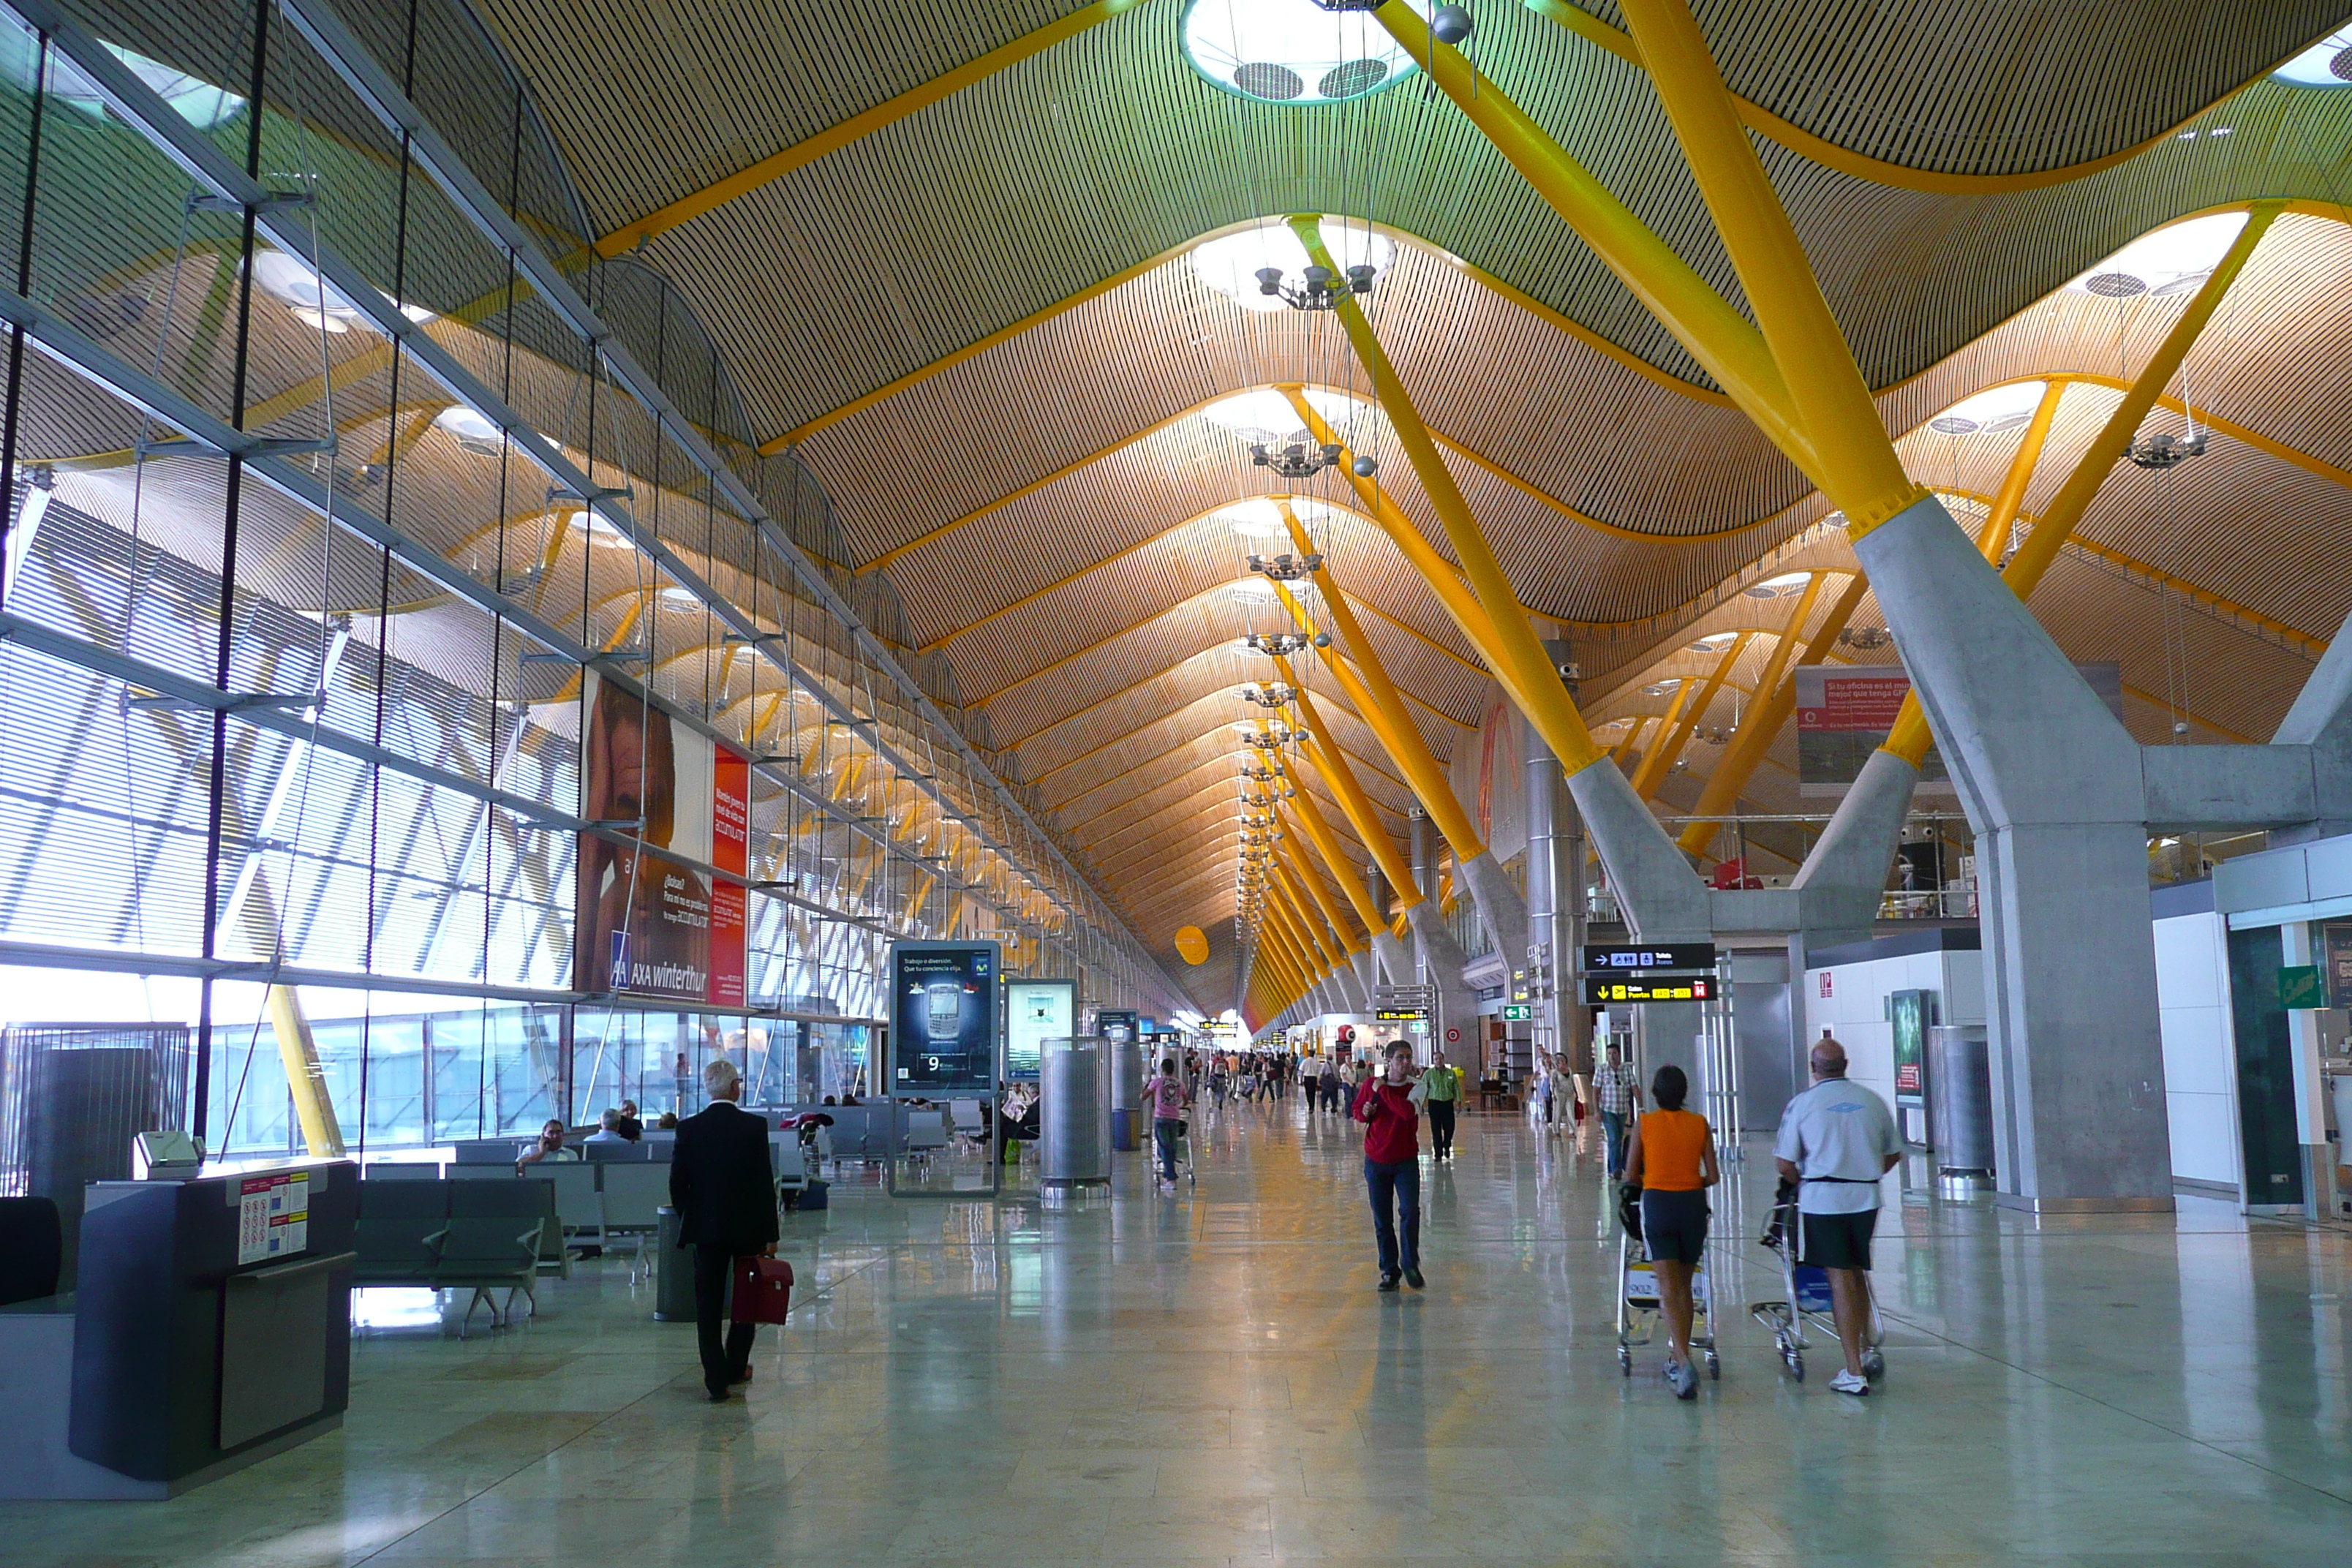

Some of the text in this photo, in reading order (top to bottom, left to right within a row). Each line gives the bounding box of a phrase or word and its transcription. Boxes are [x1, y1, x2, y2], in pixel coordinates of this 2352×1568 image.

[1847, 682, 1873, 690] oficina
[1885, 682, 1893, 690] el
[1828, 690, 1852, 698] mejor
[1852, 690, 1867, 698] que
[1869, 690, 1892, 698] tenga
[904, 965, 916, 973] Que
[611, 960, 707, 992] AA AXA winterthur
[1696, 985, 1705, 996] H
[928, 1057, 939, 1071] 9
[1629, 1284, 1651, 1294] 902
